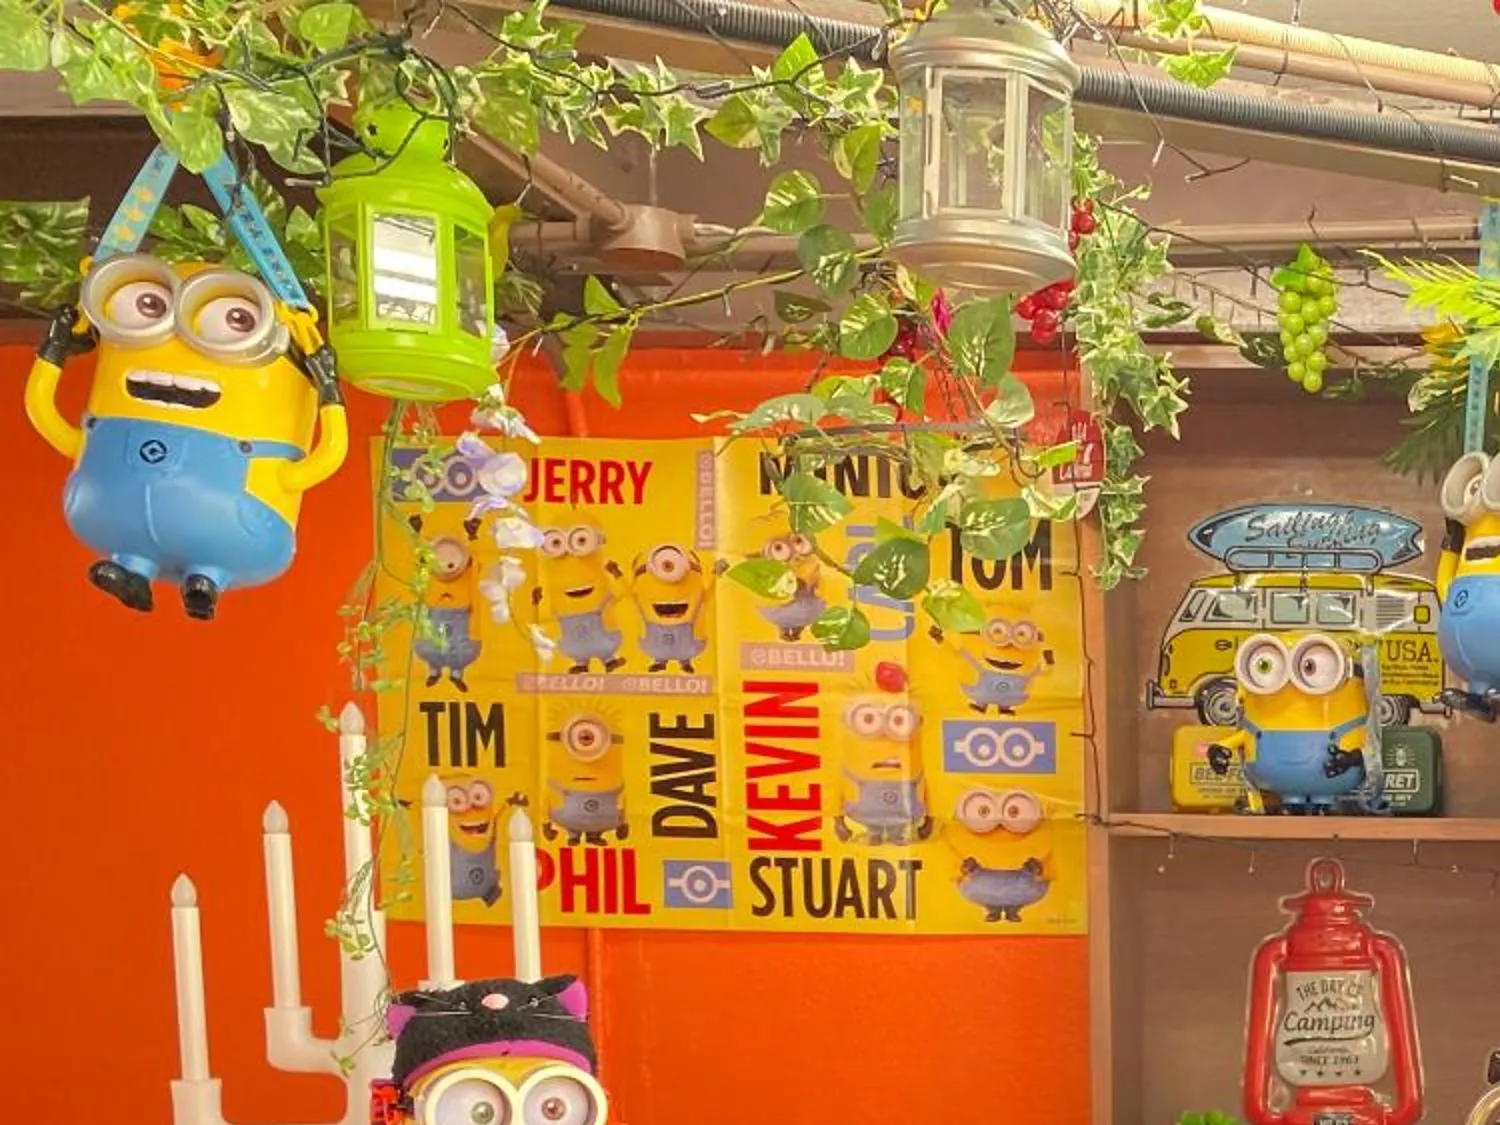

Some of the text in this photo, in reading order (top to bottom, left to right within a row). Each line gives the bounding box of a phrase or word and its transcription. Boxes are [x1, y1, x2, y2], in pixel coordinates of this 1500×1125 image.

[523, 457, 653, 505] JERRY
[419, 701, 506, 768] TIM
[742, 681, 823, 852] KEVIN
[648, 712, 719, 839] DAVE
[747, 856, 923, 921] STUART
[1283, 1010, 1376, 1039] Camping
